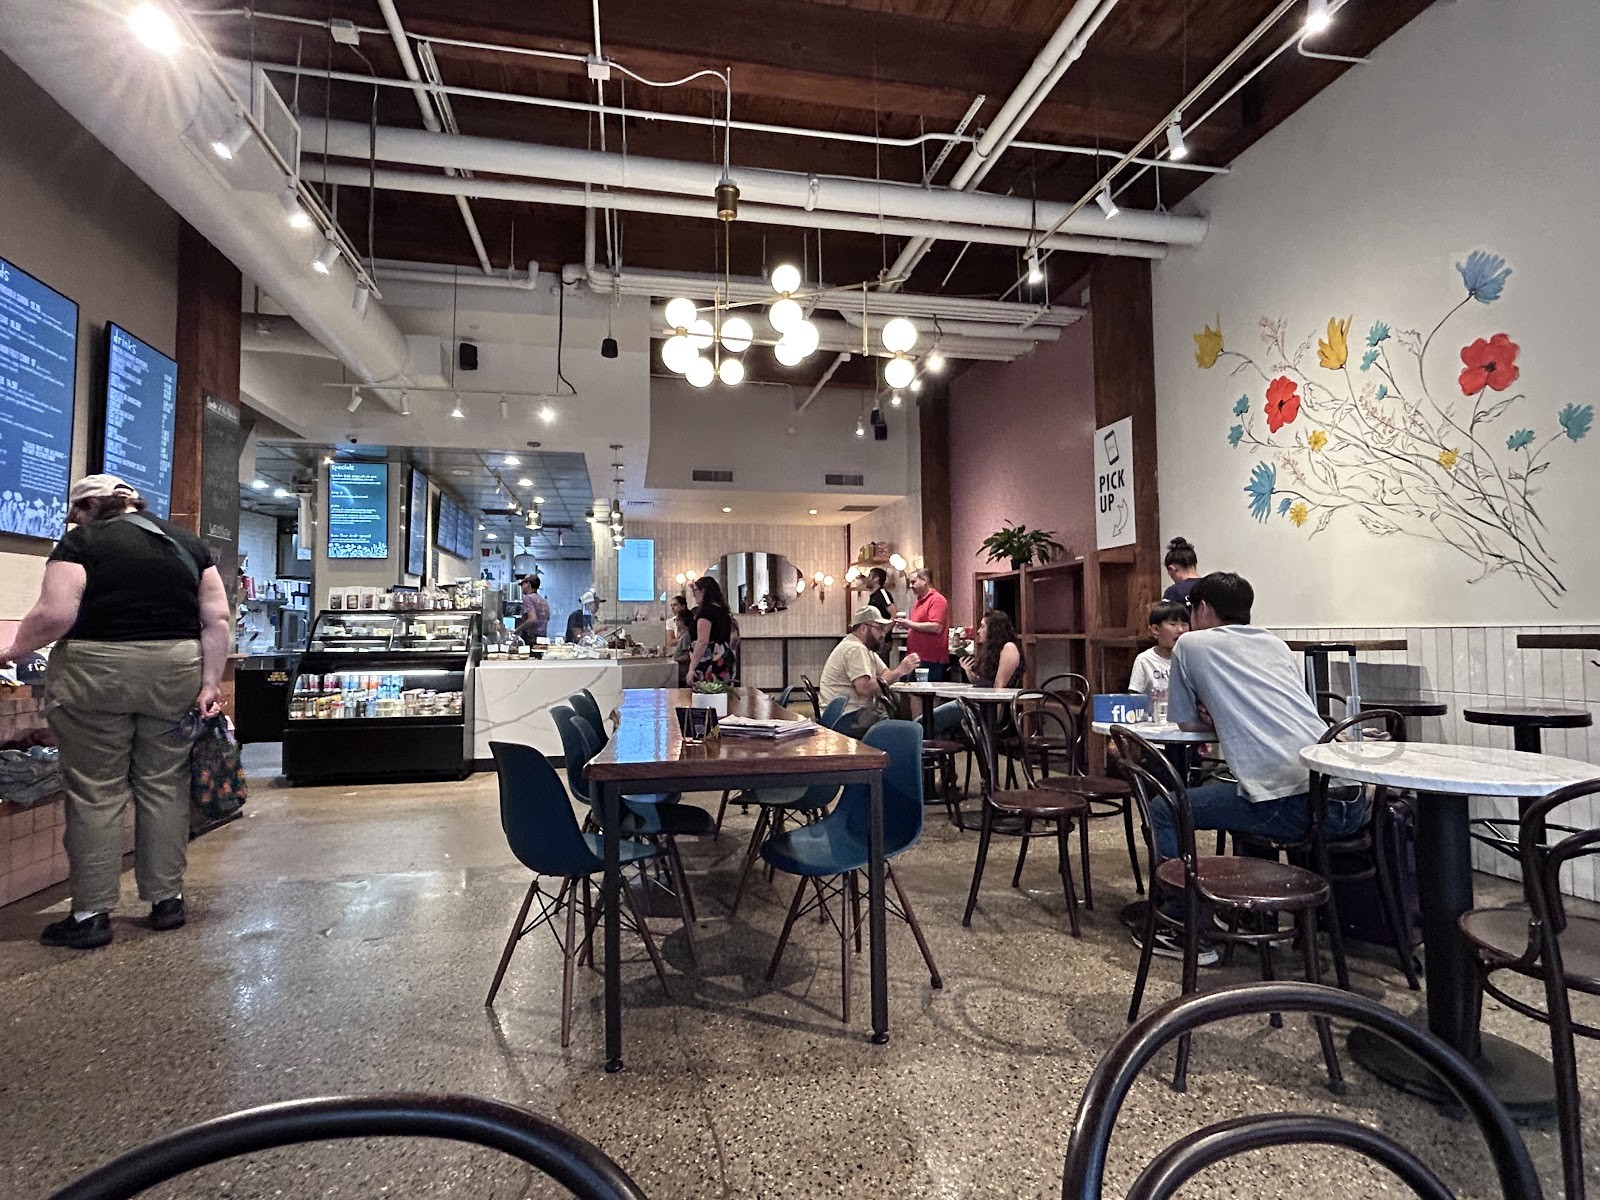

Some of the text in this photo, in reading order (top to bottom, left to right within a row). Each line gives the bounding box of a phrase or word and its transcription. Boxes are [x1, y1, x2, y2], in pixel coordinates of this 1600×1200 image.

[113, 330, 137, 355] drinks
[1099, 468, 1125, 493] PICK
[1100, 493, 1115, 513] UP
